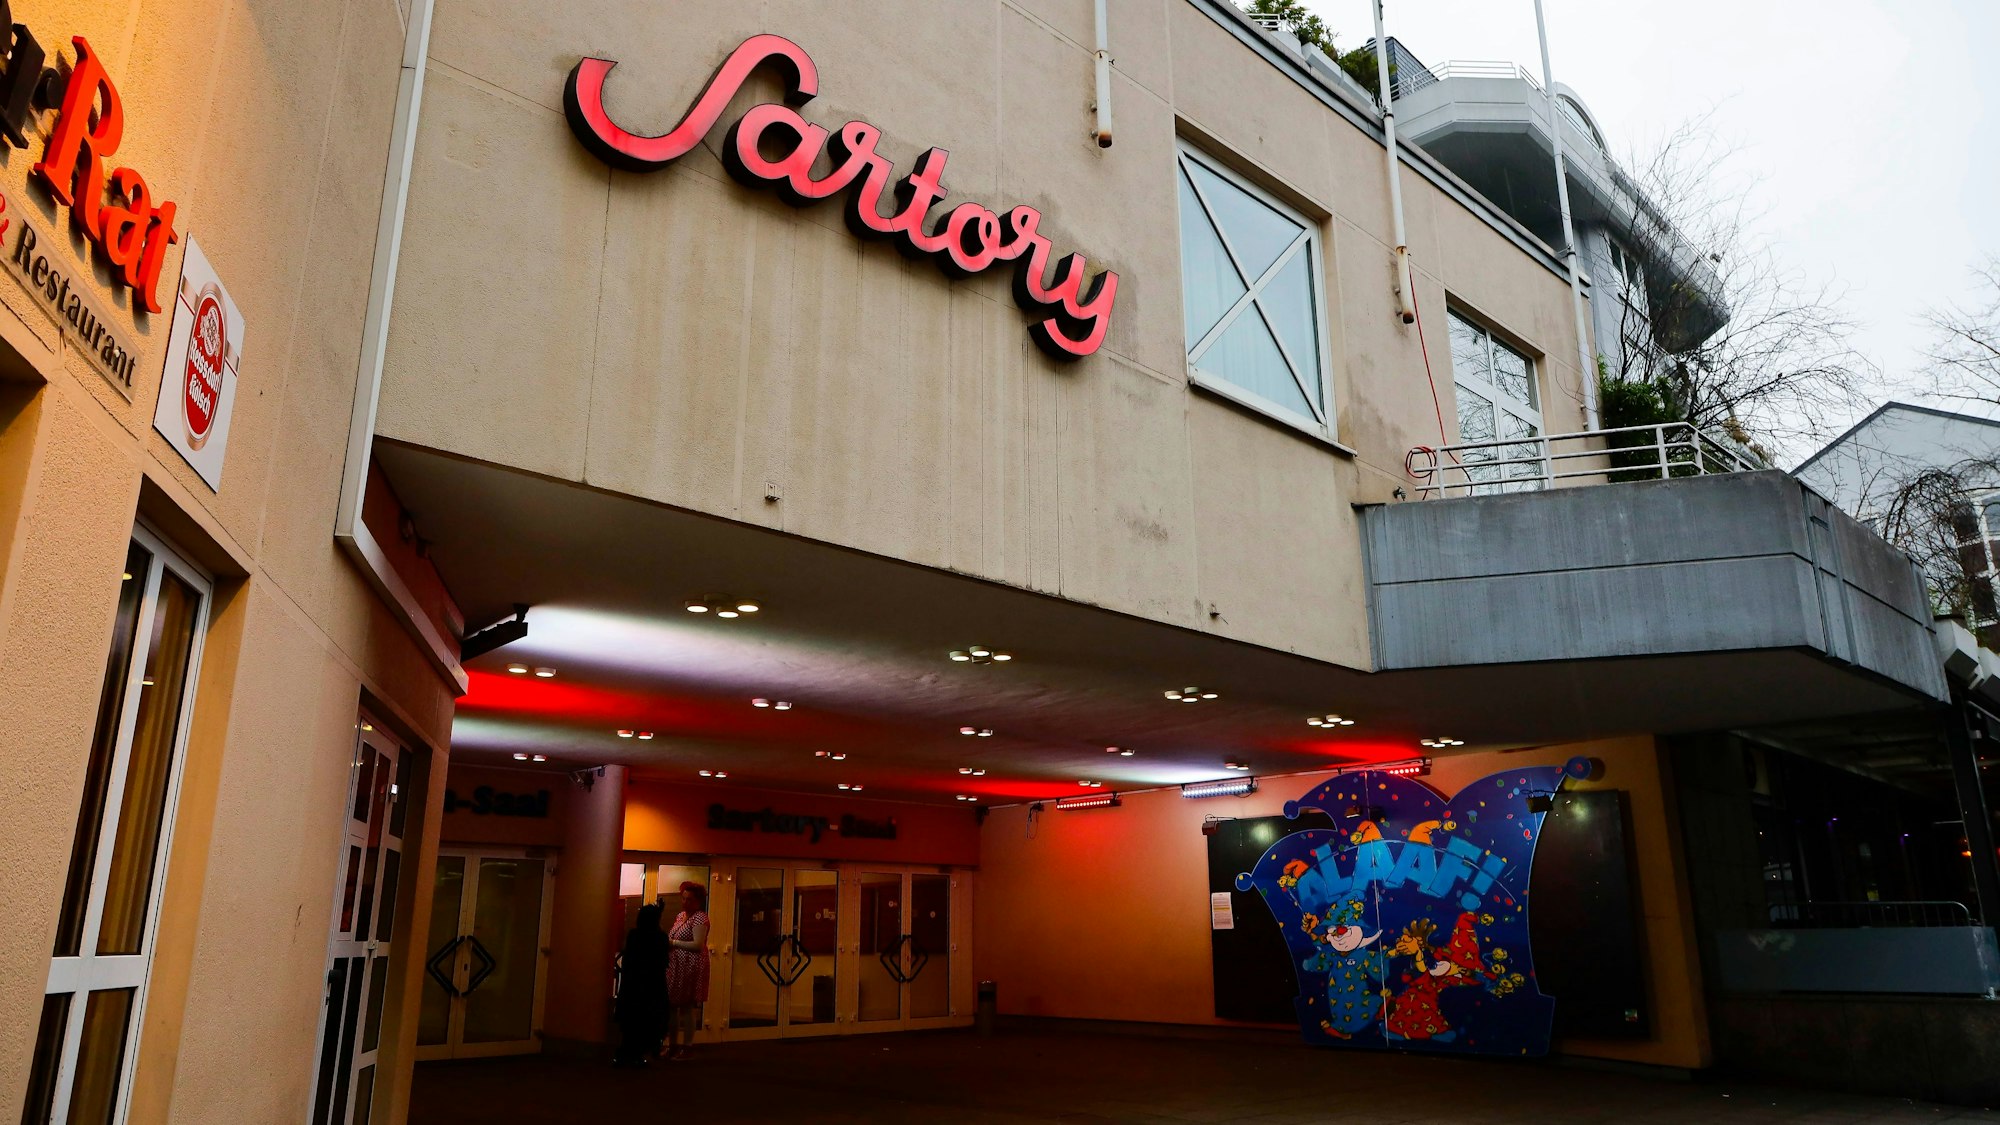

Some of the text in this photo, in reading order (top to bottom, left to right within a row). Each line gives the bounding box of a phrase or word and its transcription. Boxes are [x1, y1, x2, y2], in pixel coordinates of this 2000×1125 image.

[33, 36, 178, 314] Rat
[564, 33, 1119, 361] Sartory
[13, 218, 138, 388] Restaurant
[188, 373, 212, 421] Kölsch
[1297, 835, 1507, 911] ALAAF!
